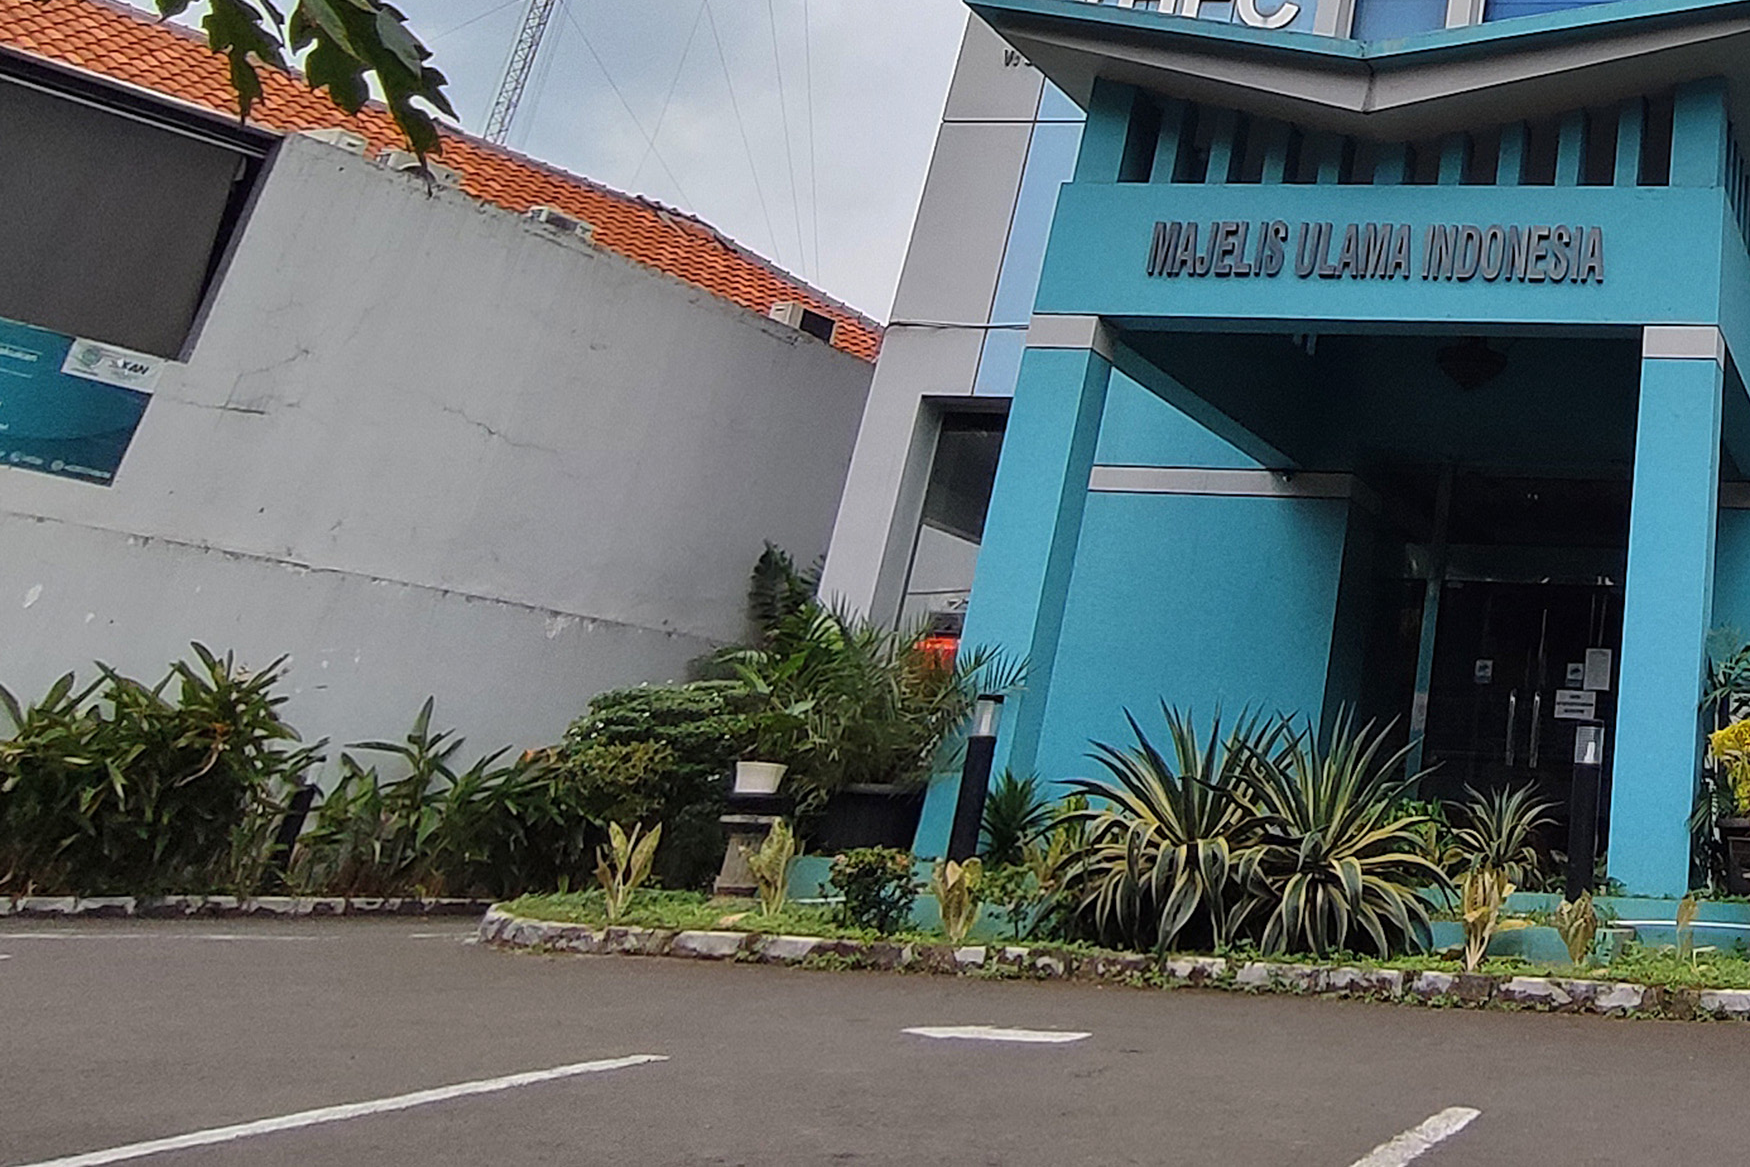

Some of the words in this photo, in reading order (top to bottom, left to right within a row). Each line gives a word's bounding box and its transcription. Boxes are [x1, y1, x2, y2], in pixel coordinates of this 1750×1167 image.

[1146, 219, 1289, 278] MAJELIS
[1296, 221, 1412, 280] ULAMA
[1421, 223, 1604, 283] INDONESIA
